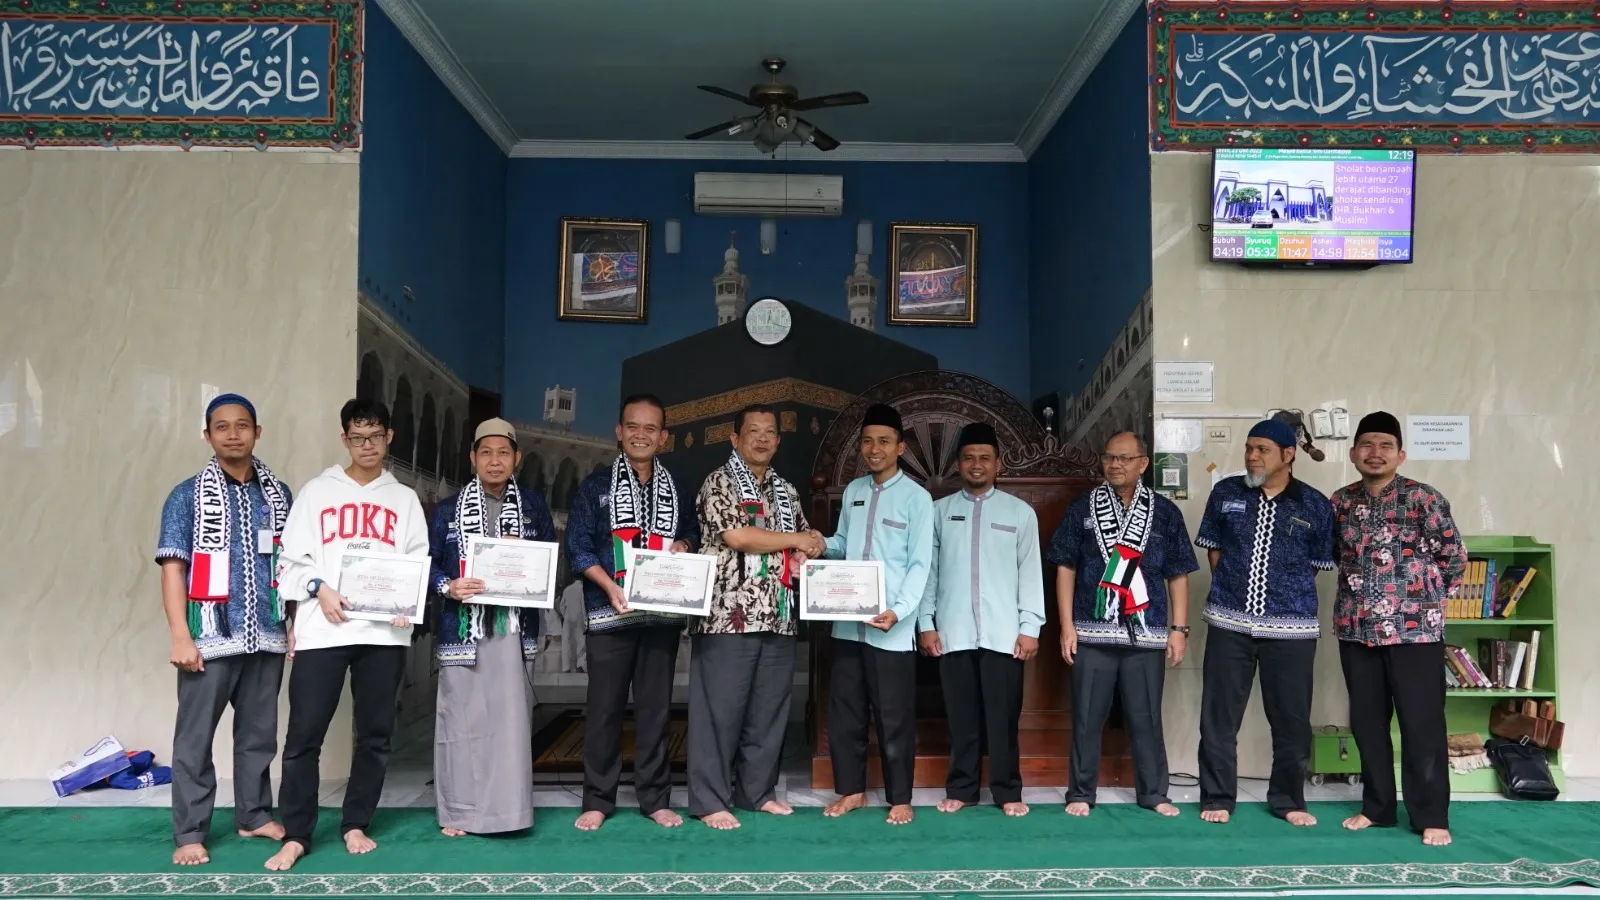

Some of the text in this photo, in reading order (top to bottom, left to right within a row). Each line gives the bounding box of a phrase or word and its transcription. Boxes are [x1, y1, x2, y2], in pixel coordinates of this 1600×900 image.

[1388, 150, 1414, 160] 12:19
[1335, 164, 1412, 174] Sholat berjamaah
[1335, 175, 1399, 184] lebih utama 27
[1335, 186, 1411, 196] derajat dibanding
[1334, 196, 1404, 204] sholat sendirian
[1353, 206, 1387, 215] Bukhari
[1388, 206, 1395, 215] &
[1333, 216, 1368, 225] Muslim)
[1213, 236, 1236, 244] Subuh
[1246, 237, 1272, 246] Syuruq
[1279, 237, 1305, 245] Dzuhur
[1345, 238, 1376, 246] Maghrib
[1379, 238, 1393, 246] Isya
[1213, 247, 1409, 258] 04:19 05:32 11:47 14:58 17:54 19:04
[657, 498, 673, 530] SAVE
[320, 503, 398, 547] COKE
